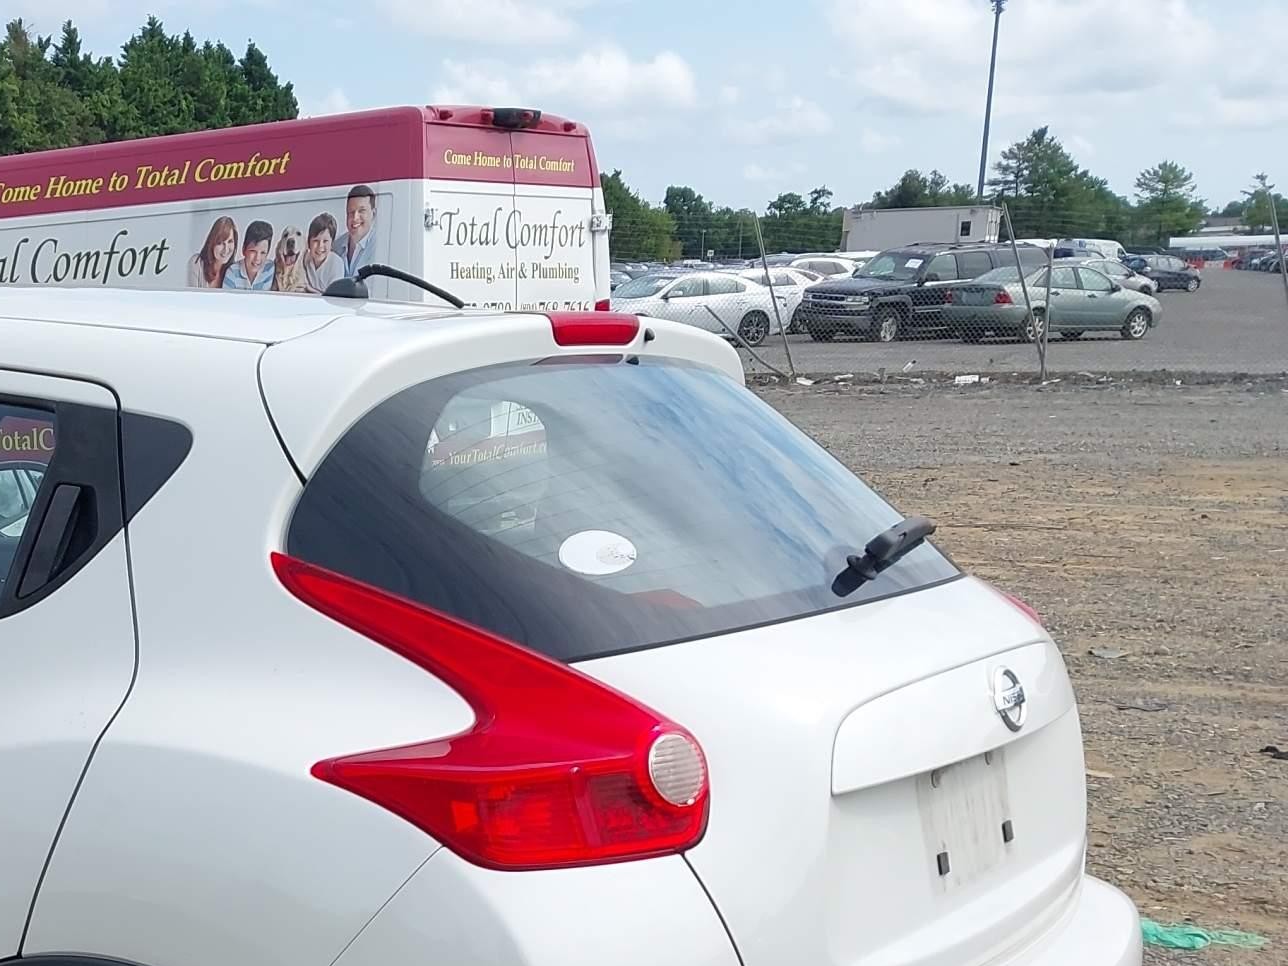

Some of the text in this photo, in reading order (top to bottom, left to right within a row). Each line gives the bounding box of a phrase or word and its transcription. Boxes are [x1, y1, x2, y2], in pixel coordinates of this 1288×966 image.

[44, 175, 104, 199] Home
[108, 171, 129, 192] to
[134, 160, 191, 189] Total
[194, 151, 291, 183] Comfort
[444, 149, 575, 173] Come Home to Total Comfort
[30, 229, 170, 284] Comfort
[439, 207, 585, 260] Total Comfort
[449, 261, 580, 284] Heating, Air & Plumbing
